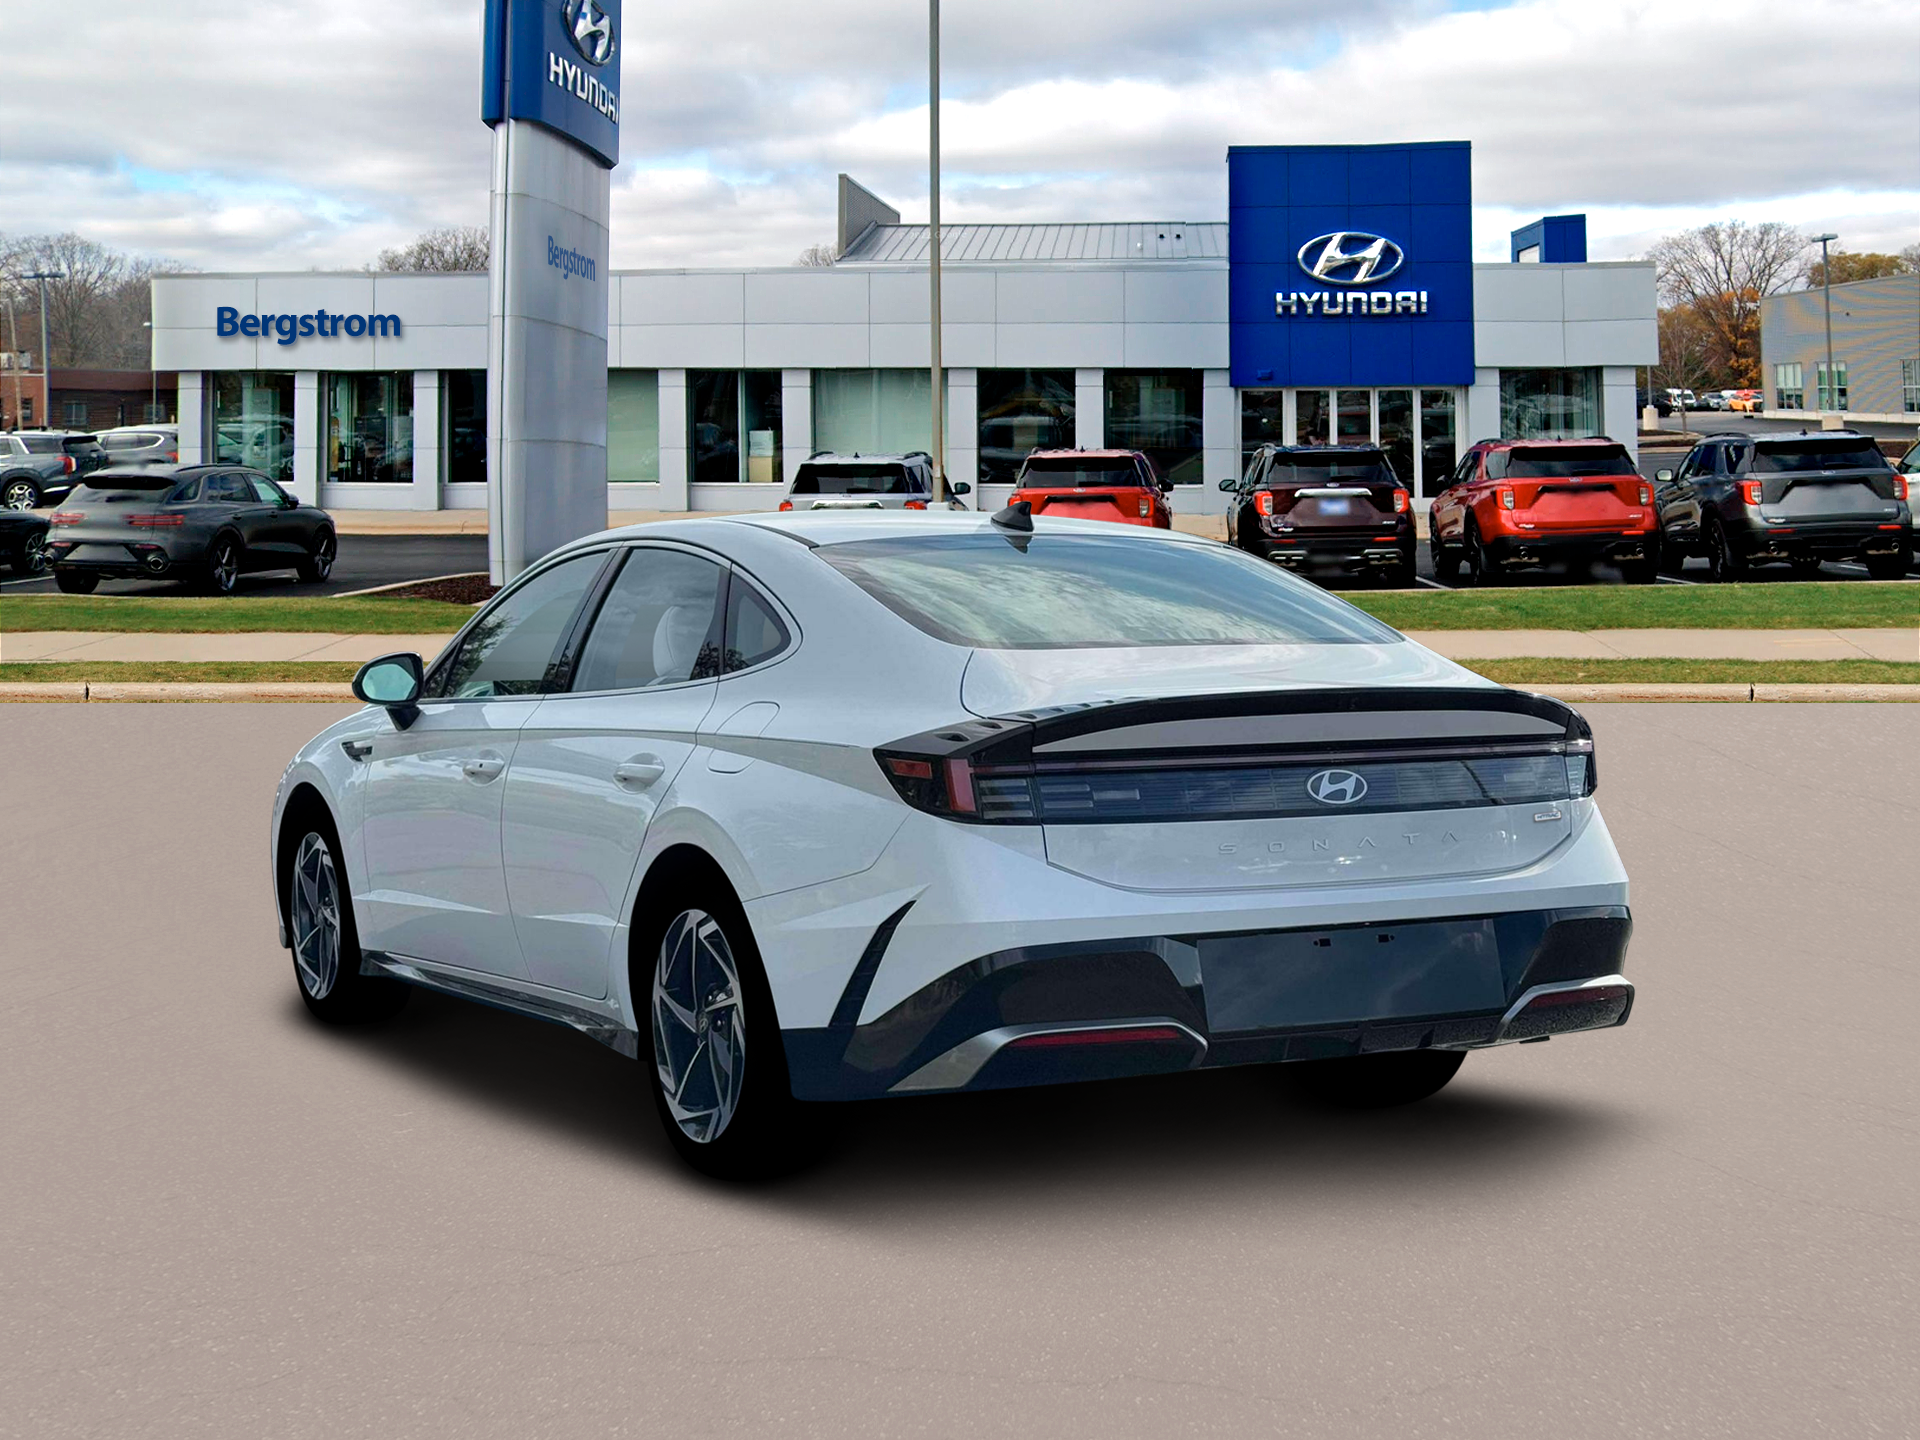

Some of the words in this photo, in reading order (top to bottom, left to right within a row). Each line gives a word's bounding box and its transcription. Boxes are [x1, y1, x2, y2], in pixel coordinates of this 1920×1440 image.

[548, 52, 619, 124] HYUNDAI
[548, 235, 596, 282] Bergstrom
[1275, 291, 1428, 315] HYUNDAI
[217, 306, 402, 346] Bergstrom
[1219, 831, 1459, 855] SONATA
